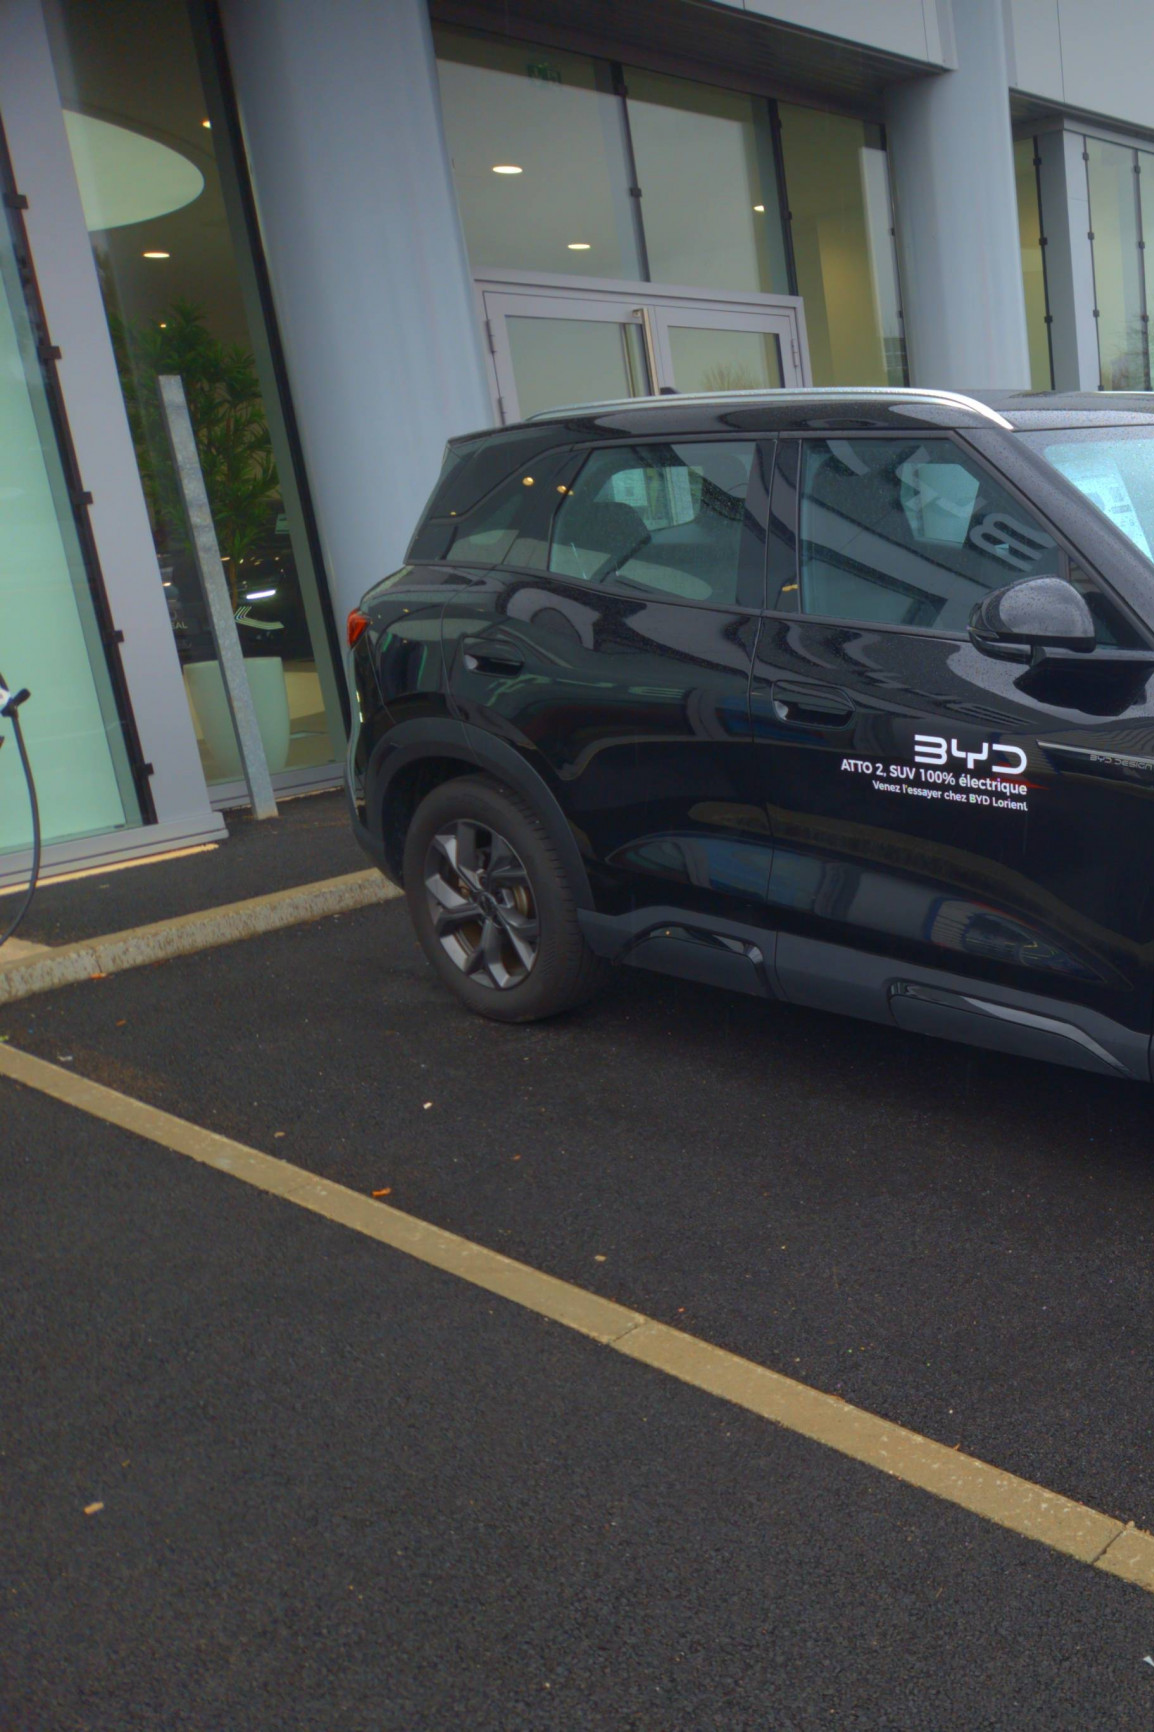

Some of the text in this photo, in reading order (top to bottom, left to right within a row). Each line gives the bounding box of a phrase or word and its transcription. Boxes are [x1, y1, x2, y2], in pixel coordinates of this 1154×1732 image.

[914, 734, 1028, 774] BYD
[1089, 754, 1153, 771] BYD DESIGN
[840, 758, 1028, 796] ATTO 2, SUV 100% électrique
[872, 780, 901, 793] Venez
[902, 783, 942, 799] l'essayer
[943, 790, 967, 802] chez
[969, 793, 990, 806] BYD
